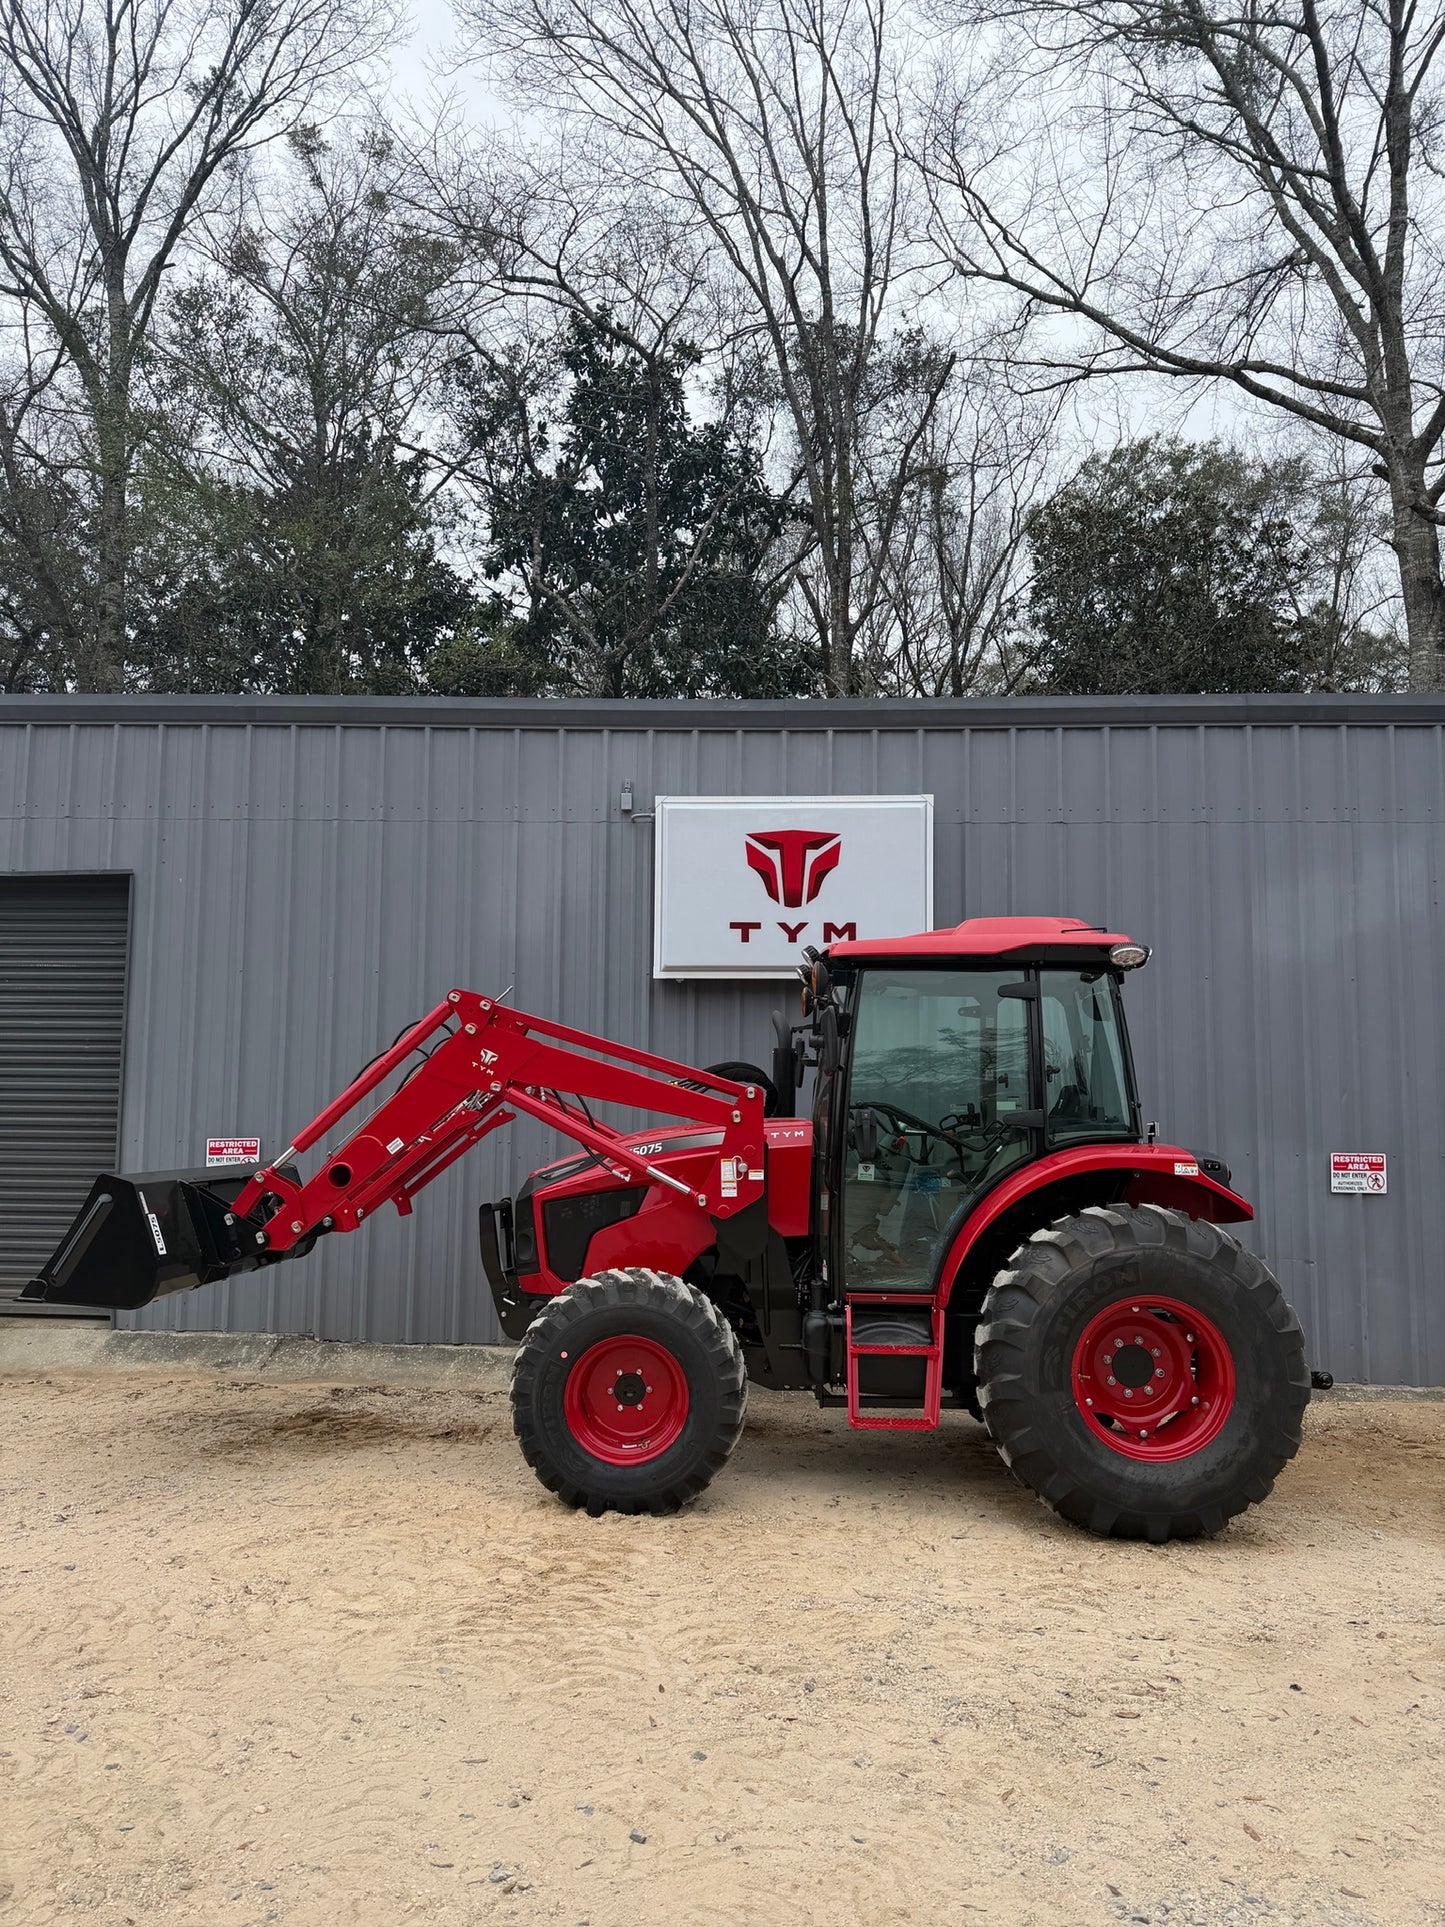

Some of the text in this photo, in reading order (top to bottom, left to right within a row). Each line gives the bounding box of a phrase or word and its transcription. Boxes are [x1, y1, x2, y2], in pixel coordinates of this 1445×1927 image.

[729, 921, 857, 943] TYM
[472, 1061, 494, 1076] TYM
[770, 1131, 804, 1139] TYM
[209, 1140, 257, 1148] RESTRICTED
[630, 1142, 663, 1156] 5075
[1333, 1155, 1383, 1164] RESTRICTED
